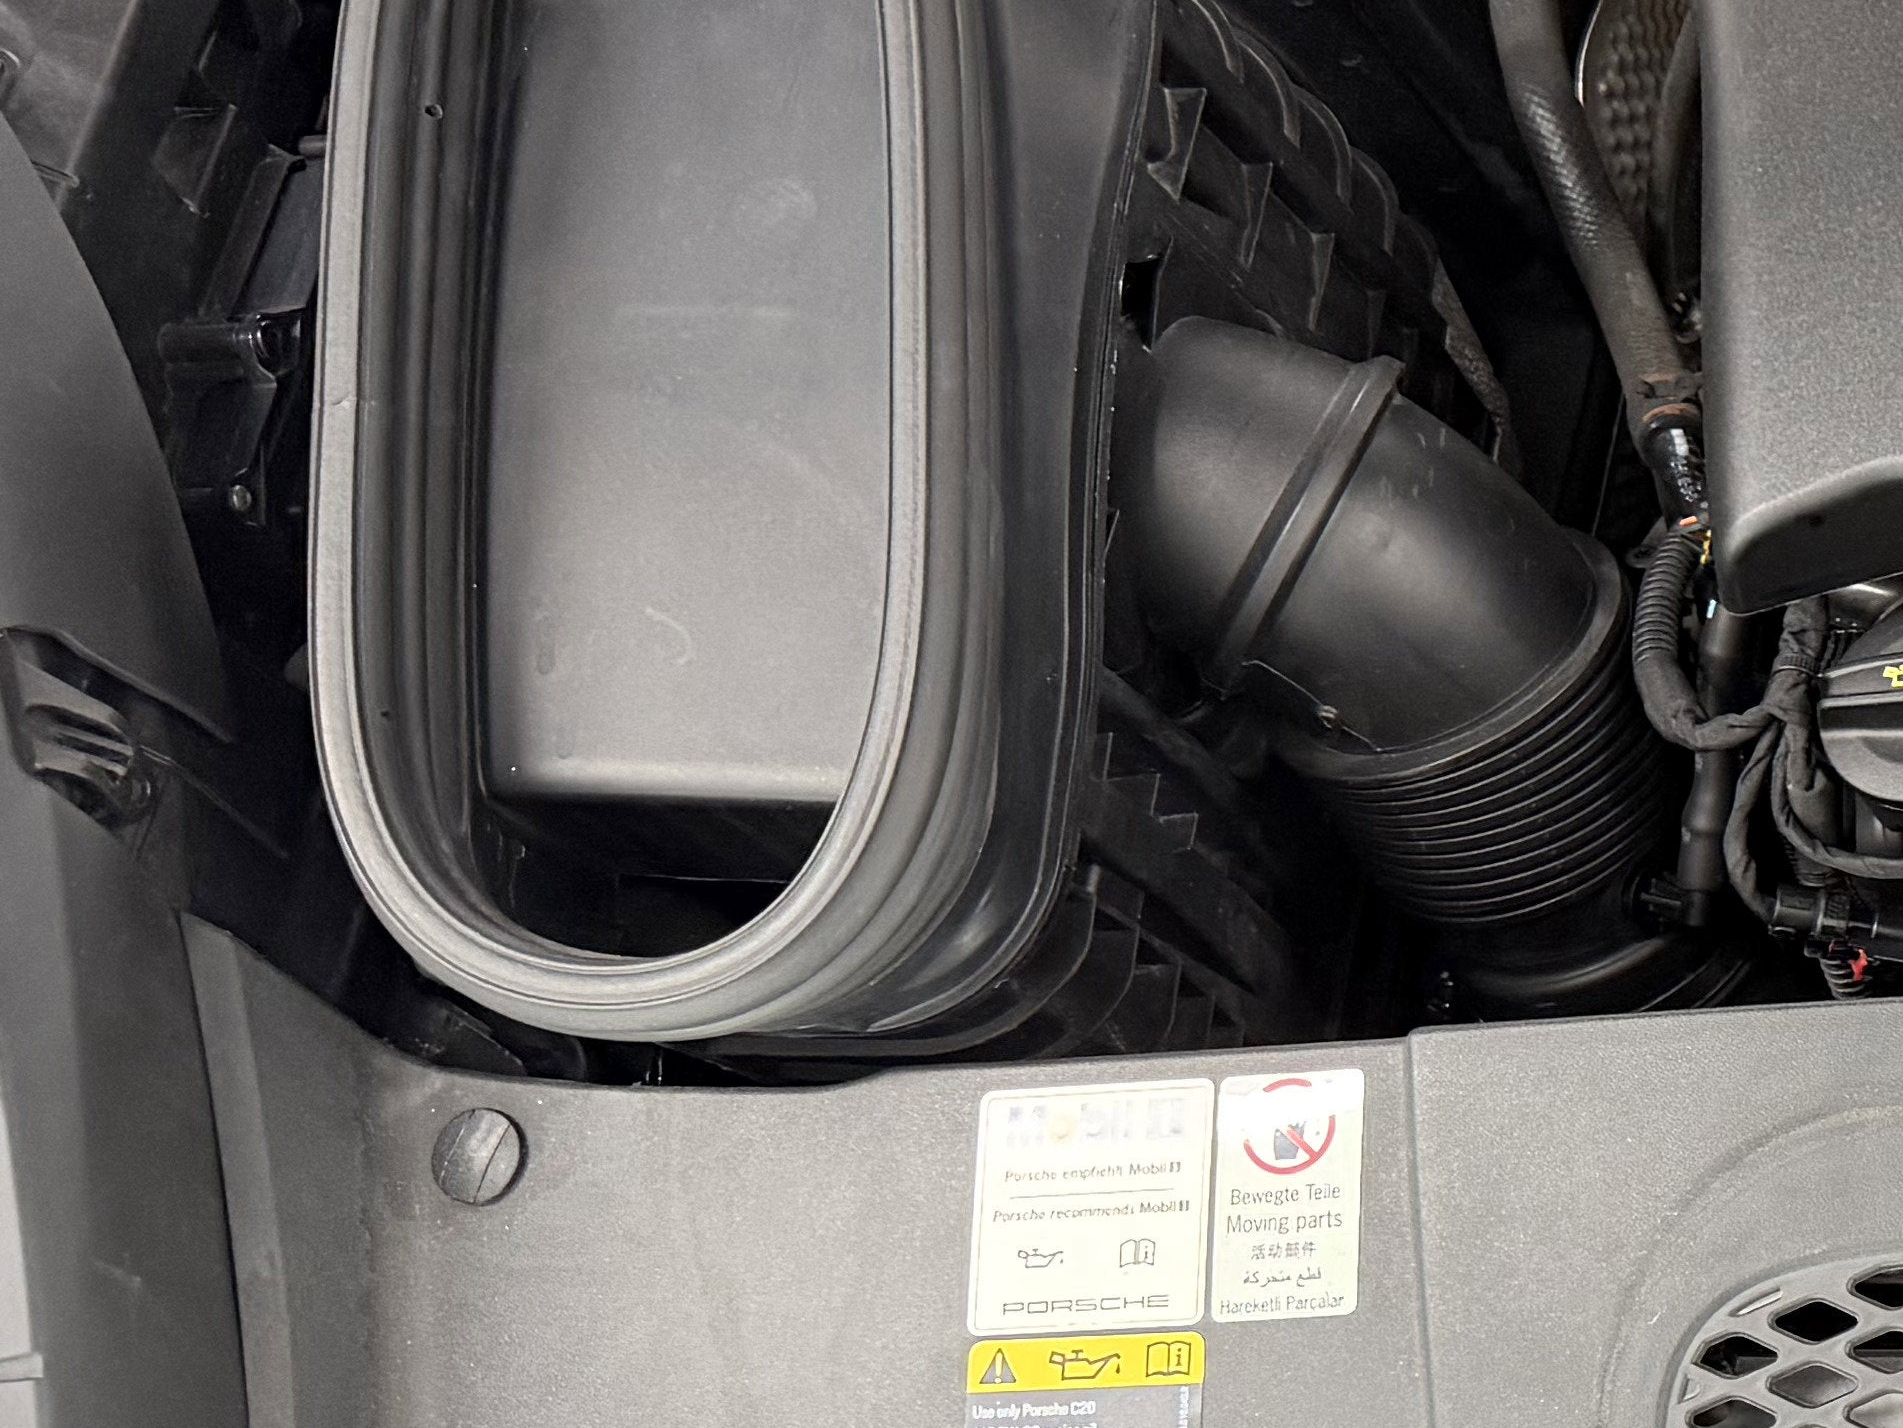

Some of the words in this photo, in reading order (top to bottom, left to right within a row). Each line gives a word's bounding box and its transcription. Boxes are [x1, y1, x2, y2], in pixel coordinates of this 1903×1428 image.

[1230, 1187, 1300, 1206] Bewegte
[1226, 1214, 1290, 1235] Moving
[1296, 1209, 1343, 1233] parts
[1002, 1294, 1170, 1316] PORSCHE
[972, 1404, 995, 1420] Use
[1022, 1402, 1069, 1418] Porsche
[1070, 1400, 1097, 1416] C20
